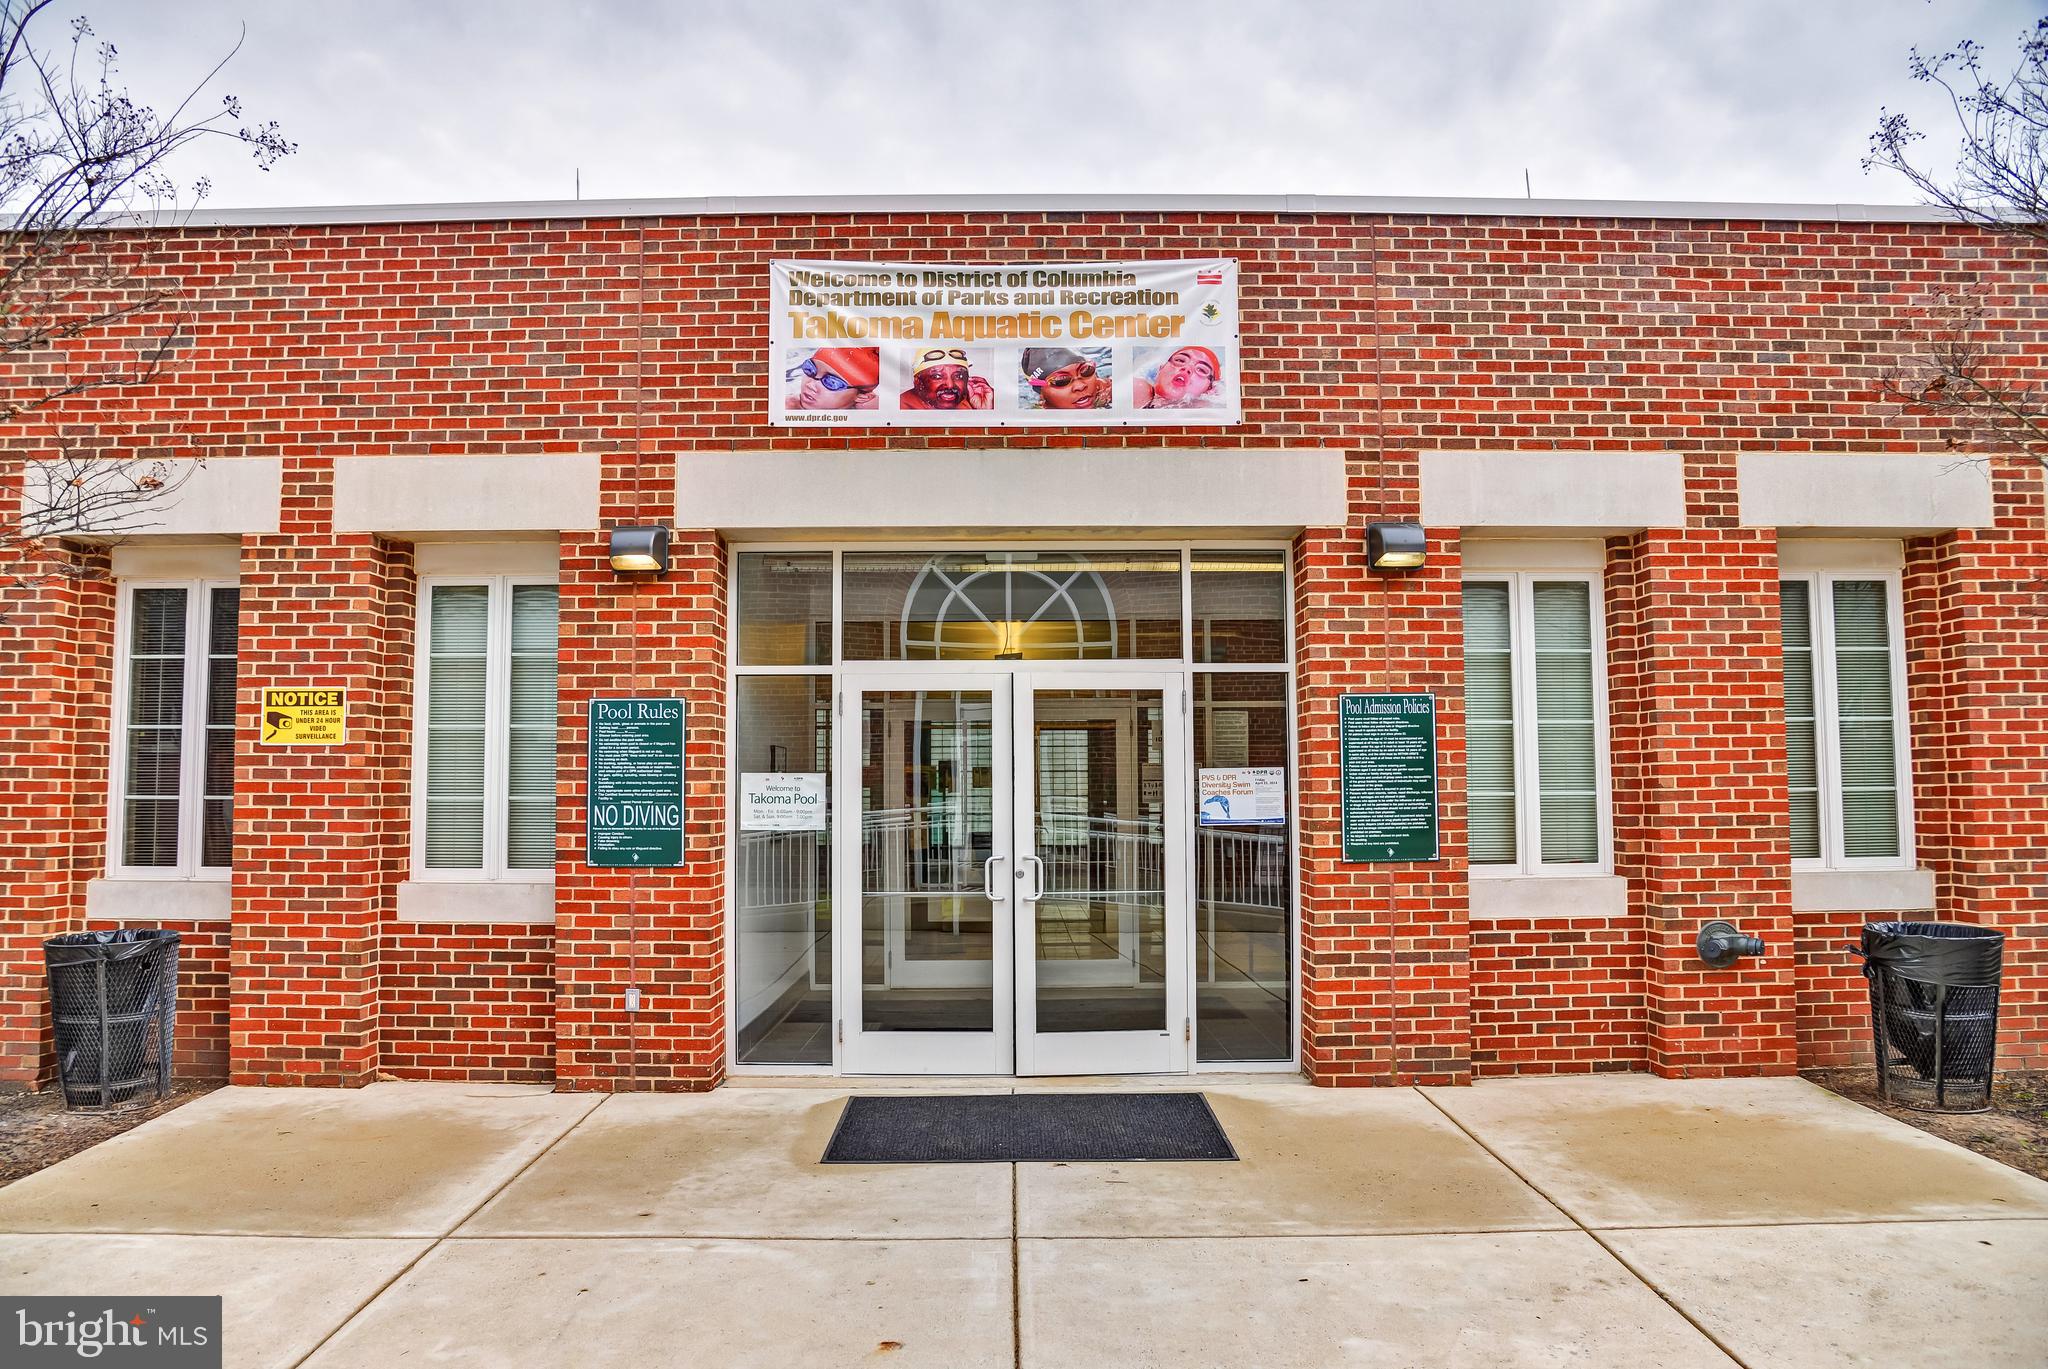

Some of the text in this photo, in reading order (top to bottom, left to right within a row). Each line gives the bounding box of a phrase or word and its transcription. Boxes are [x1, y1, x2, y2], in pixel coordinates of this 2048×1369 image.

[788, 269, 1137, 289] Welcome to District of Columbia
[788, 288, 1180, 308] Department of Parks and Recreation
[787, 309, 1186, 342] Takoma Aquatic Center
[784, 413, 849, 423] www.dpr.dc.gov
[272, 692, 338, 705] NOTICE
[1346, 698, 1429, 714] Pool Admission Policies
[598, 703, 679, 719] Pool Rules
[749, 793, 817, 804] Takoma Pool
[594, 804, 680, 826] NO DIVING
